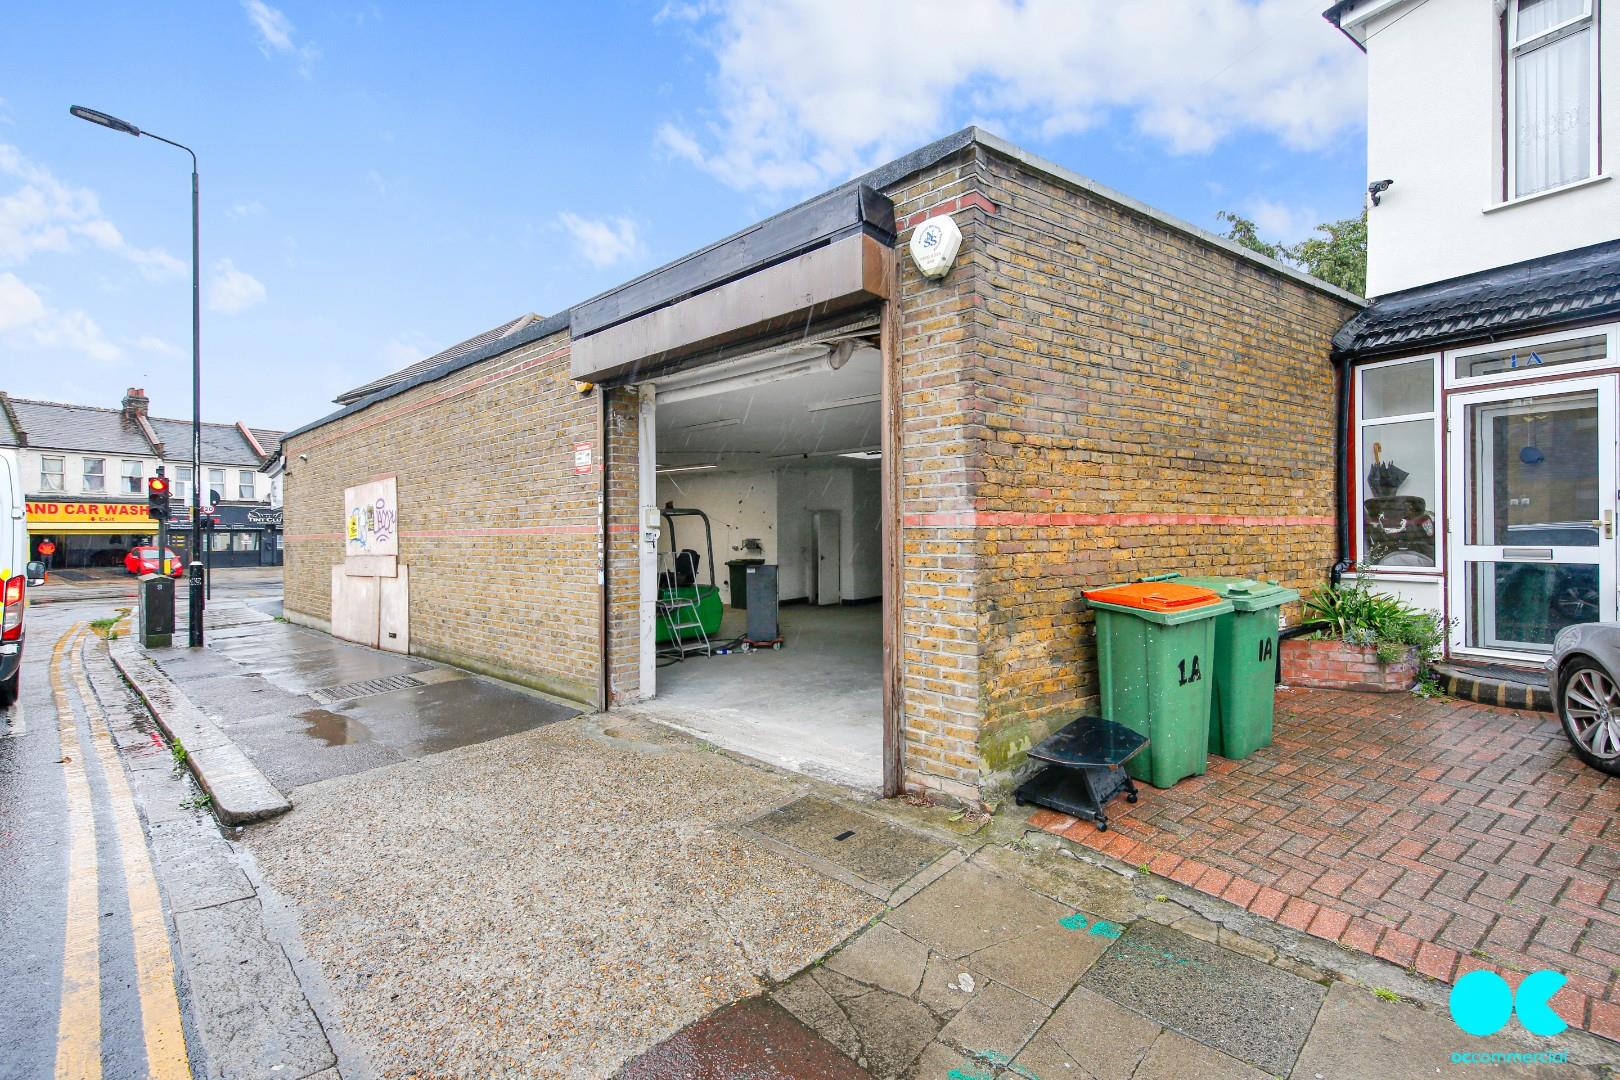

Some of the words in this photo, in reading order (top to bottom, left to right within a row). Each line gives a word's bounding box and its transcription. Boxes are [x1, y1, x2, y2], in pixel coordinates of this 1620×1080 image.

[25, 503, 58, 514] AND
[64, 504, 99, 515] CAR
[103, 505, 151, 515] WASH
[1257, 636, 1273, 663] 1A
[1177, 655, 1202, 687] 1A
